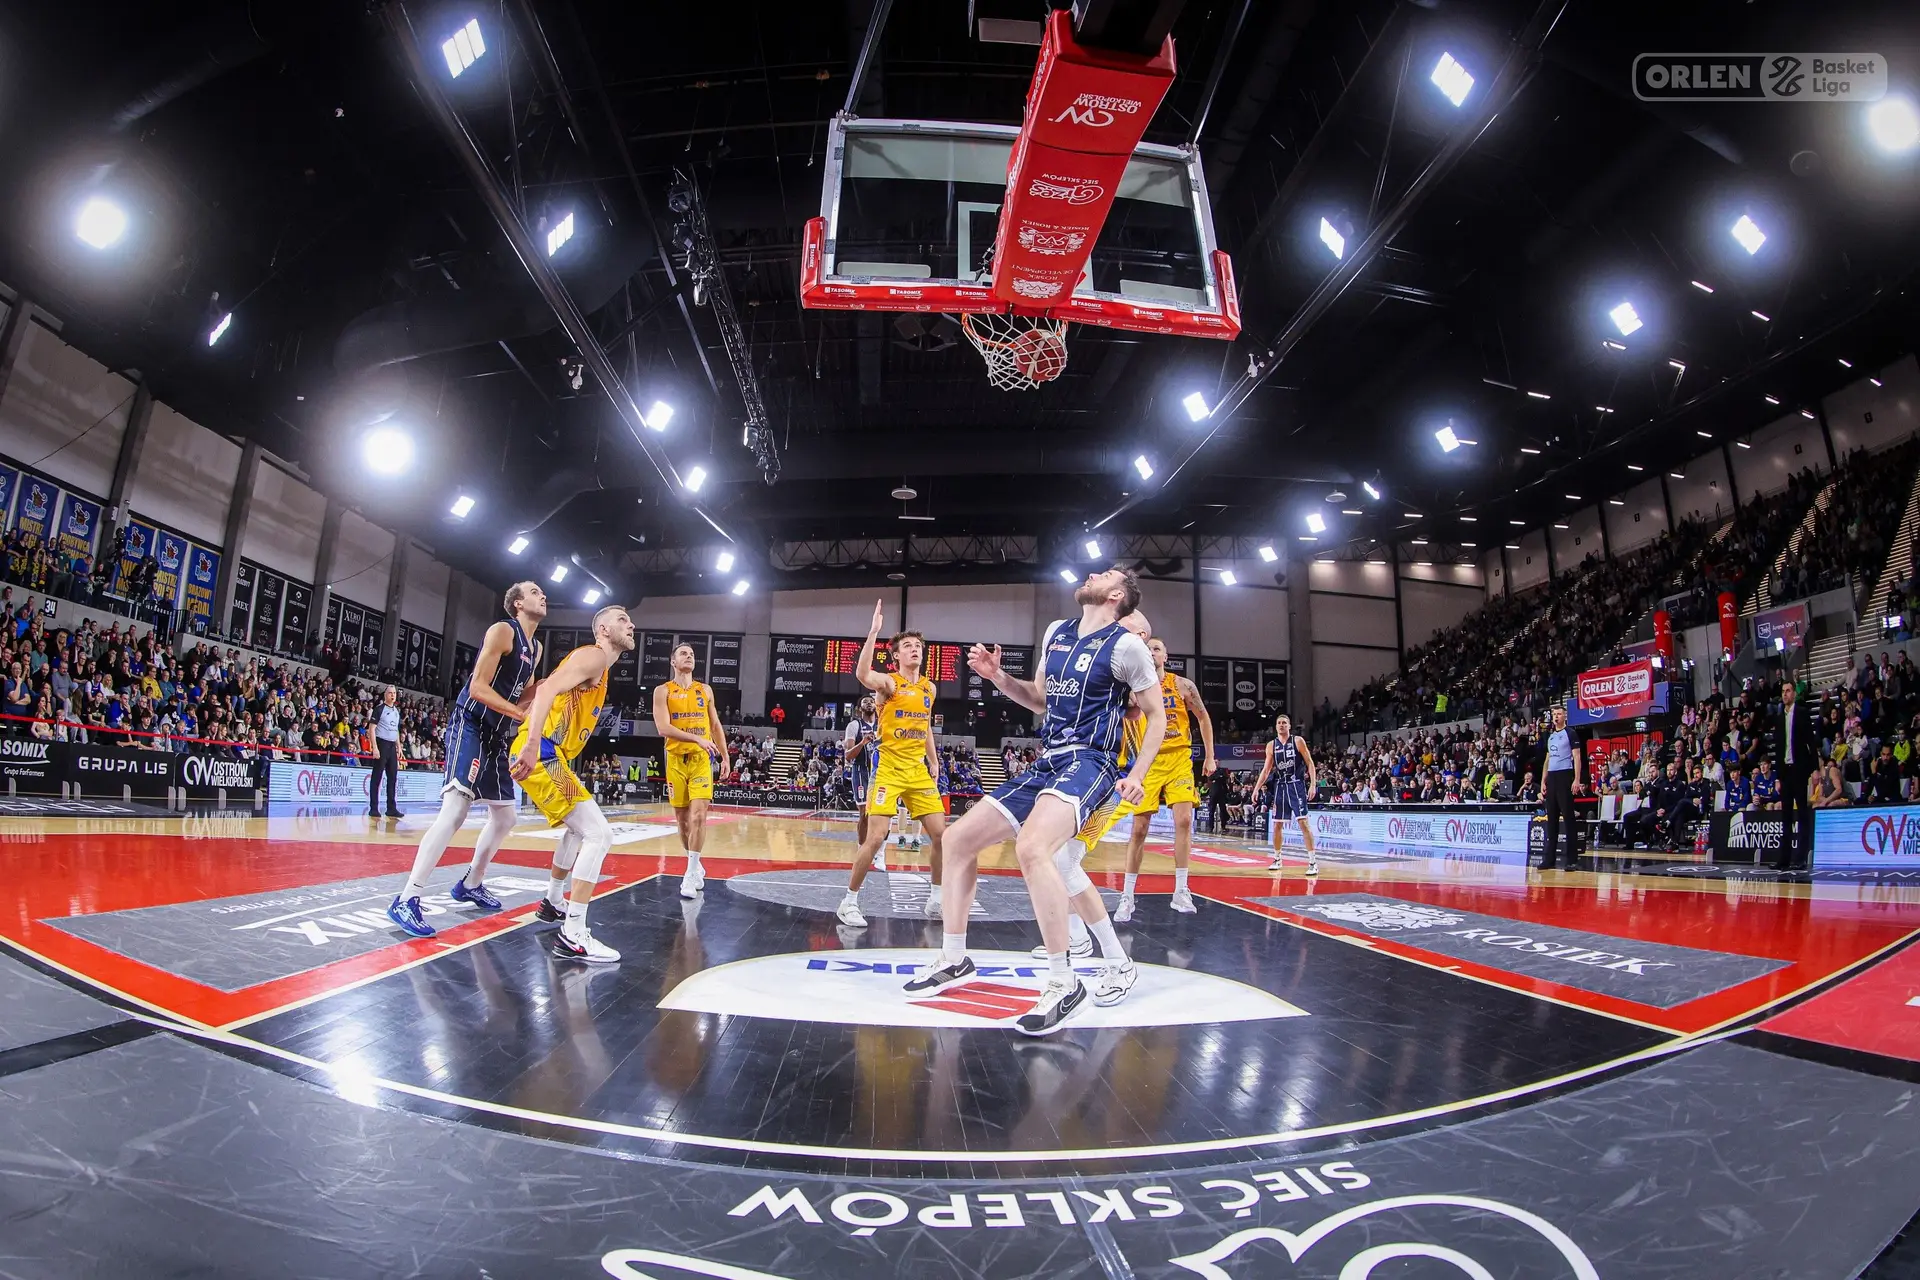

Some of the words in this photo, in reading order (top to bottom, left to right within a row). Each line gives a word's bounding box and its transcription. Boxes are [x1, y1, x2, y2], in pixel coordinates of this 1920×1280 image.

[1079, 93, 1142, 107] WIELKOPOLSKI
[1011, 264, 1074, 275] DEVELOPMENT
[1027, 273, 1058, 281] ROSIEK
[830, 287, 856, 295] TASOMIX
[1077, 300, 1103, 309] TASOMIX
[1199, 316, 1222, 324] TASOMIX
[19, 517, 45, 535] MISTRZ
[46, 600, 56, 615] 34
[259, 656, 267, 667] 35
[1075, 653, 1093, 672] 8
[1627, 672, 1646, 682] Basket
[1584, 681, 1613, 694] ORLEN
[1627, 683, 1639, 691] Liga
[697, 697, 705, 708] 3
[78, 756, 138, 773] GRUPA
[145, 762, 168, 774] LIS
[213, 759, 249, 777] OSTRÓW
[210, 775, 253, 788] WIELKOPOLSKI
[320, 773, 349, 786] OSTRÓW
[319, 786, 353, 797] WIELKOPOLSKI
[714, 789, 761, 800] graficolor
[778, 794, 817, 803] KORTRANS
[1406, 820, 1431, 833] OSTRÓW
[1466, 821, 1497, 835] OSTRÓW
[1746, 820, 1799, 834] COLOSSEM
[1405, 831, 1435, 841] WIELKOPOLSKI
[1465, 834, 1502, 845] WIELKOPOLSKI
[1445, 928, 1676, 976] ROSIEK
[1200, 1161, 1371, 1218] SIEĆ
[726, 1184, 1184, 1237] SKLEPÓW
